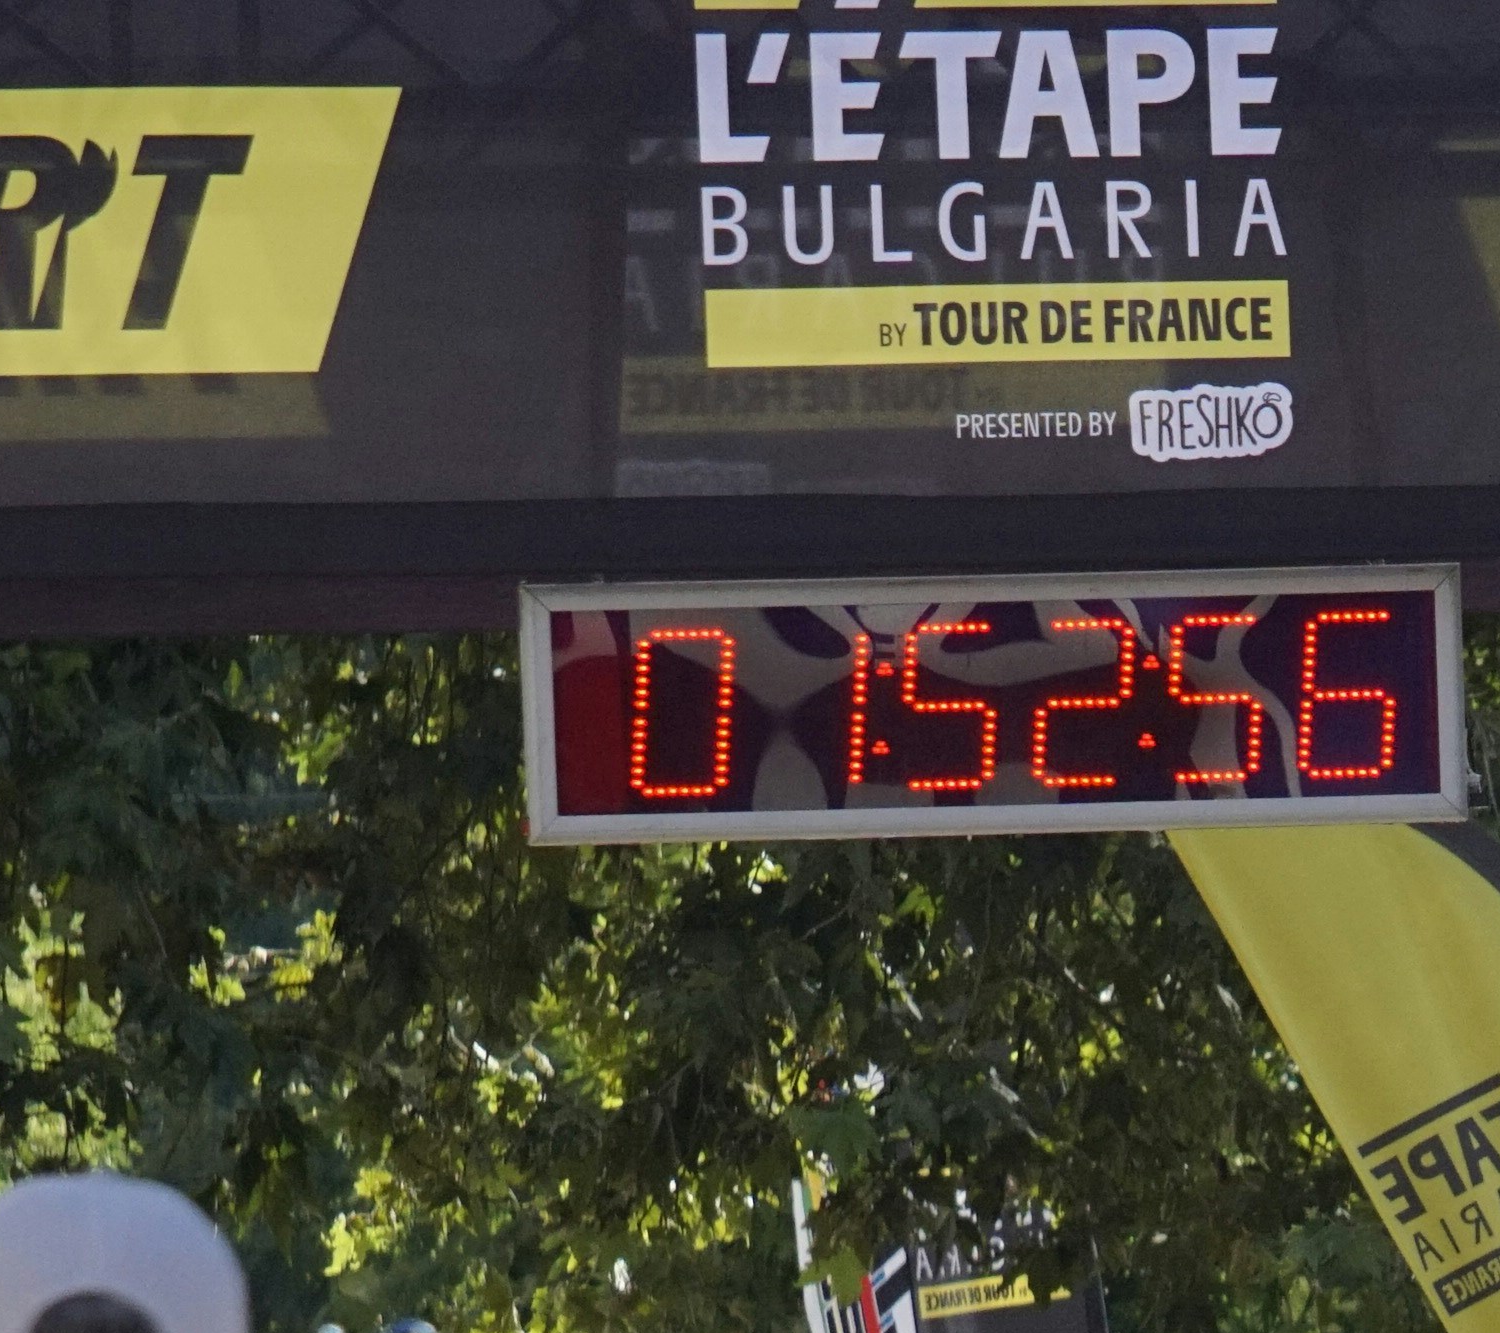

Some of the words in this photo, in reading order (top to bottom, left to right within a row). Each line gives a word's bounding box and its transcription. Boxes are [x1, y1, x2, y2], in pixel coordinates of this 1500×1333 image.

[701, 178, 1288, 266] BULGARIA
[879, 324, 908, 348] BY
[913, 301, 1029, 347] TOUR
[1041, 299, 1093, 345] DE
[1104, 296, 1273, 344] FRANCE
[956, 412, 1082, 439] PRESENTED
[1089, 411, 1117, 437] BY
[1140, 392, 1284, 453] FRESHKO
